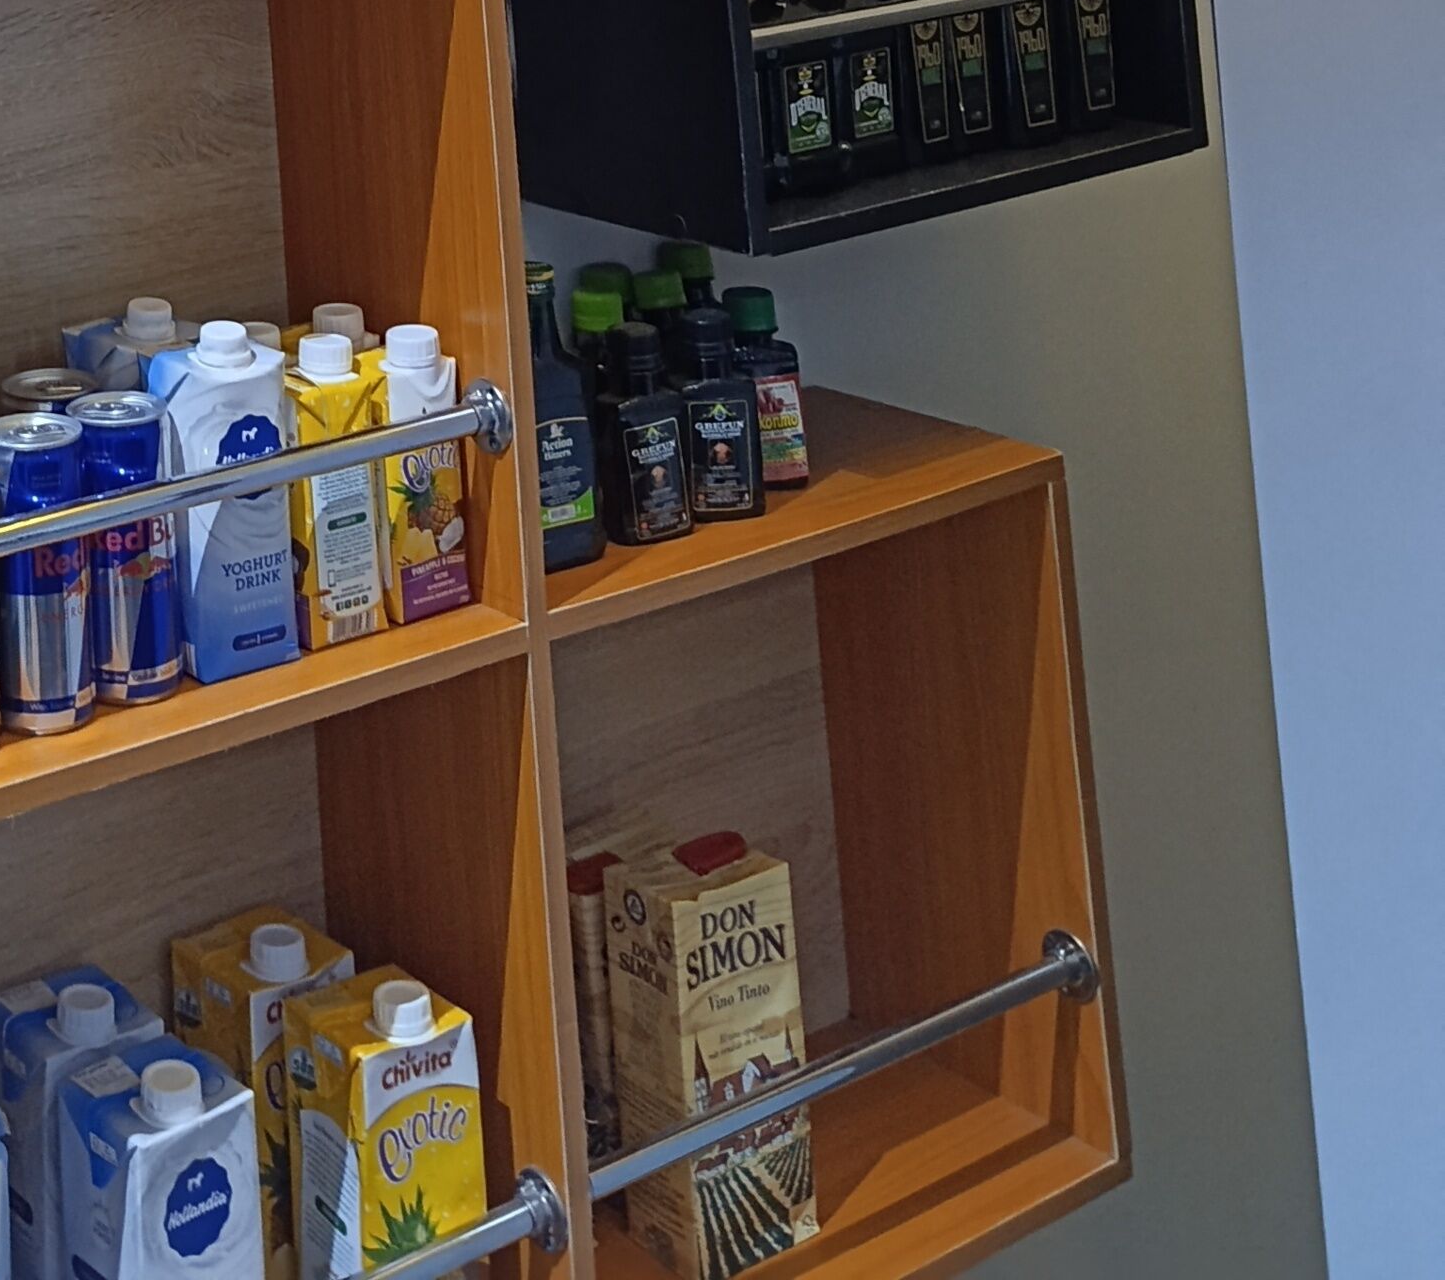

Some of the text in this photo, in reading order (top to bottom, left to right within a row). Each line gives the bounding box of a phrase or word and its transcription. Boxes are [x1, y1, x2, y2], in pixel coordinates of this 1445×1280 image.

[541, 436, 573, 452] Action
[221, 548, 288, 580] YOGHURT
[235, 568, 282, 592] DRINK
[700, 899, 756, 940] DON
[686, 924, 787, 991] SIMON
[707, 983, 771, 1012] Vino Tinto
[382, 1047, 452, 1091] Chivita
[377, 1094, 468, 1184] exotic
[166, 1190, 229, 1231] Hollandia
